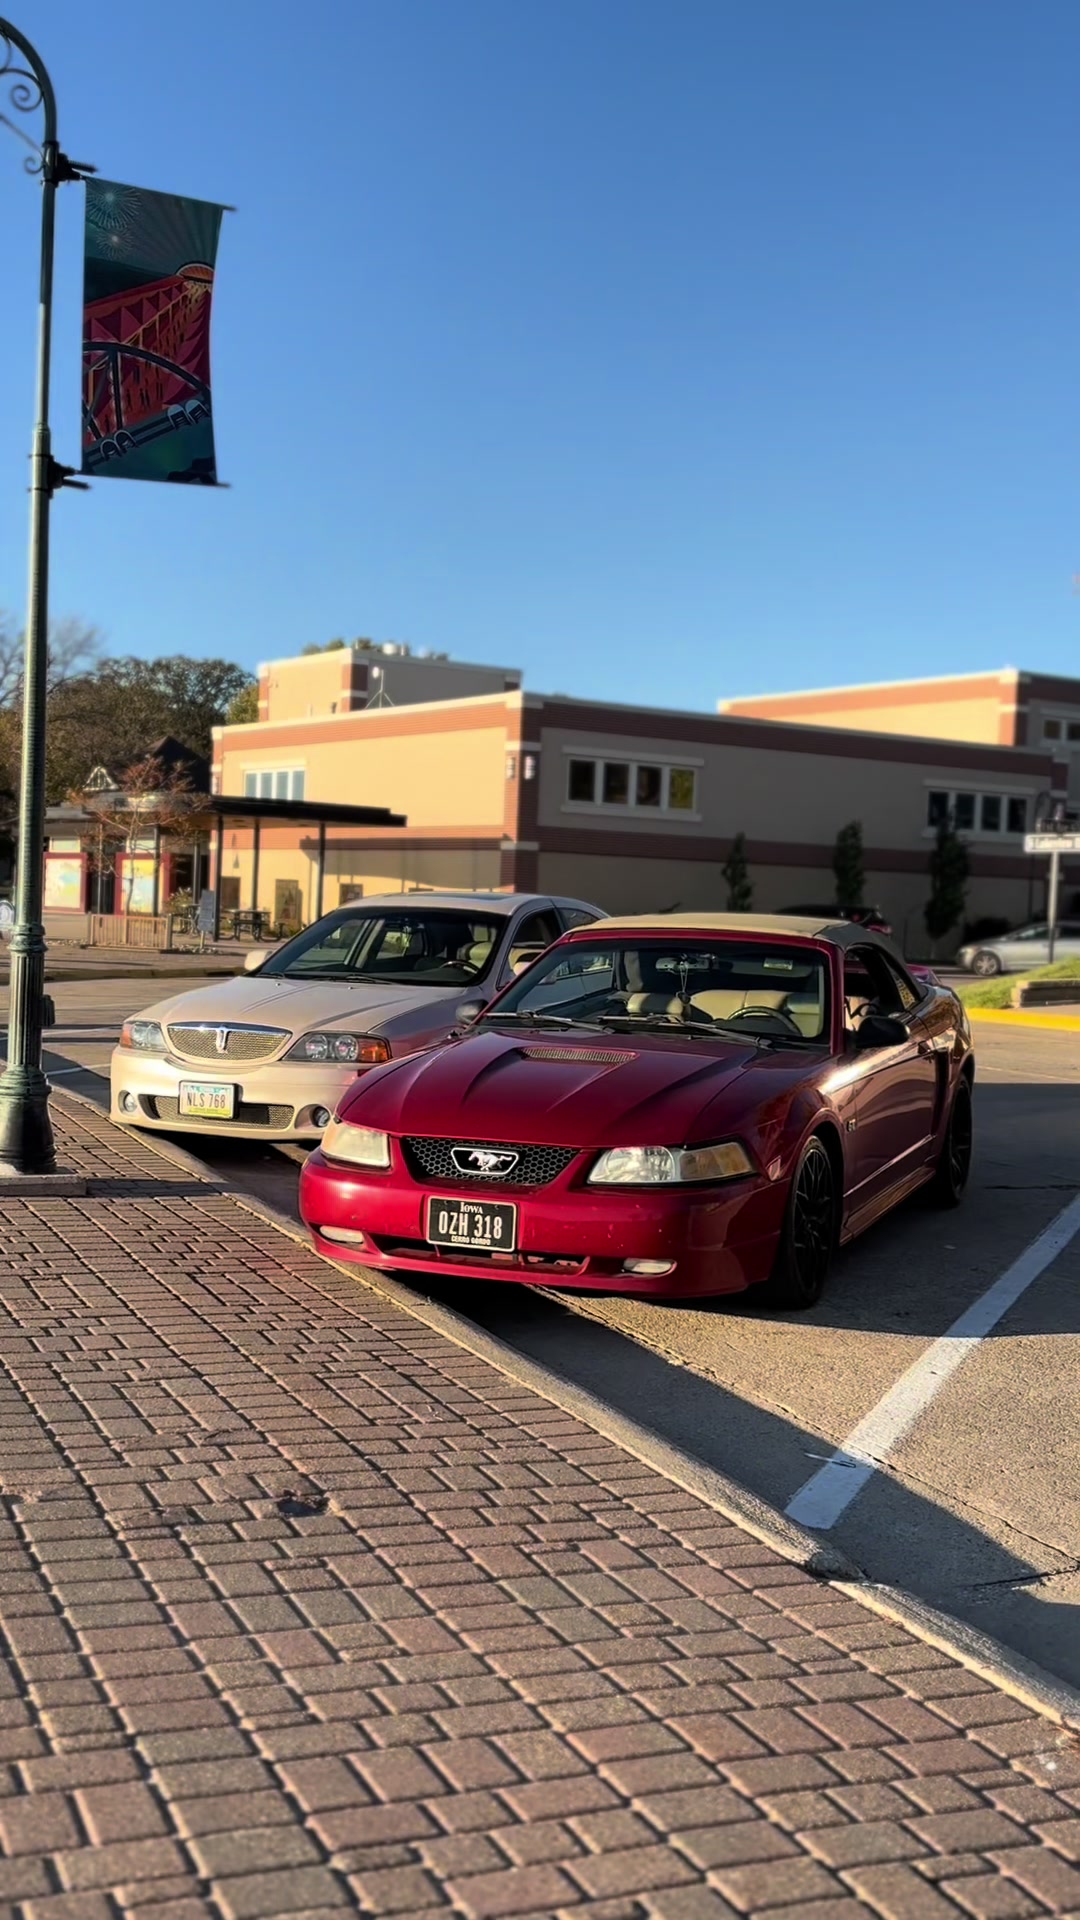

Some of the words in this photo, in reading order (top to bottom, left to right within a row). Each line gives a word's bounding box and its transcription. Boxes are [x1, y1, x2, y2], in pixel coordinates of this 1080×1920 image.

[187, 1092, 205, 1107] NLS
[209, 1093, 225, 1109] 768
[474, 1214, 503, 1239] 318
